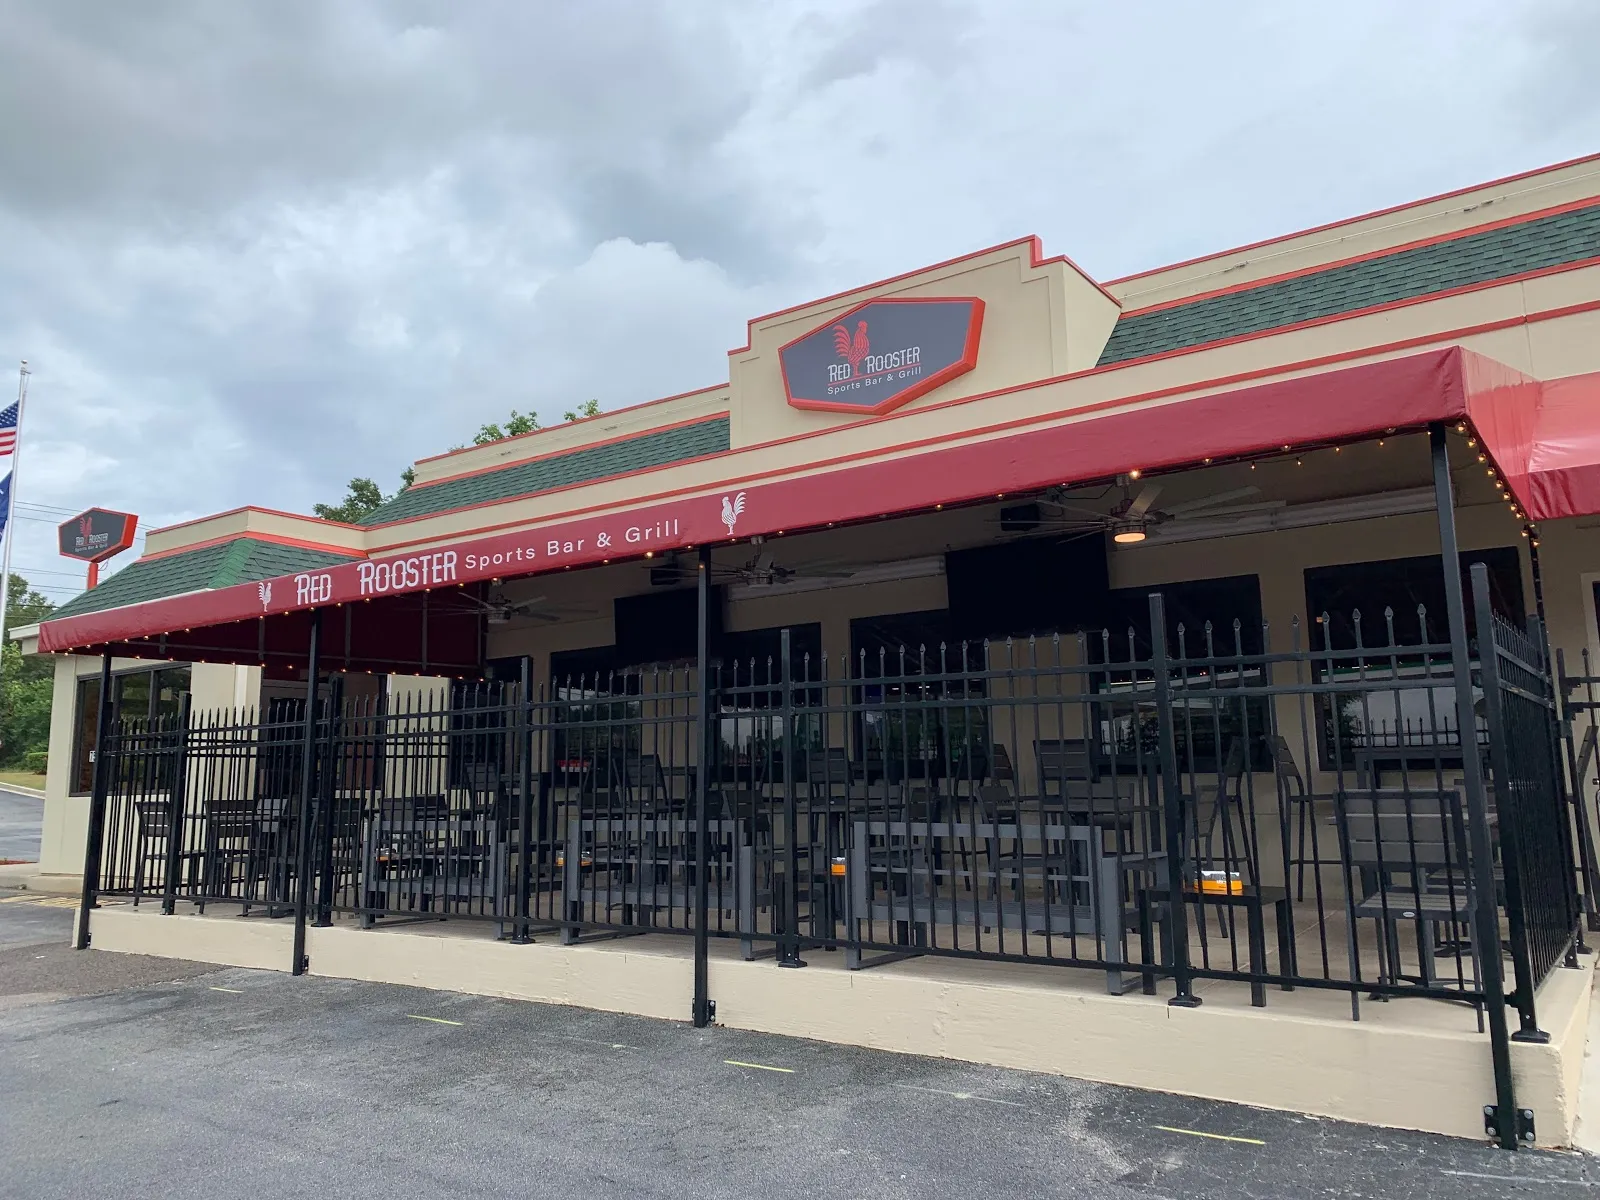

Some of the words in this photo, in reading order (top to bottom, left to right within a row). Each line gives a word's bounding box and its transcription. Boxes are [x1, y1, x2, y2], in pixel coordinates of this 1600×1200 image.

[827, 363, 851, 382] RED
[865, 346, 921, 374] ROOSTER
[827, 381, 860, 395] Sports
[865, 376, 882, 386] Bar
[887, 373, 894, 381] &
[899, 366, 922, 379] Grill
[294, 573, 332, 606] RED
[357, 551, 457, 595] ROOSTER
[465, 545, 536, 570] Sports
[547, 538, 585, 556] Bar
[596, 532, 612, 548] &
[625, 518, 679, 543] Grill
